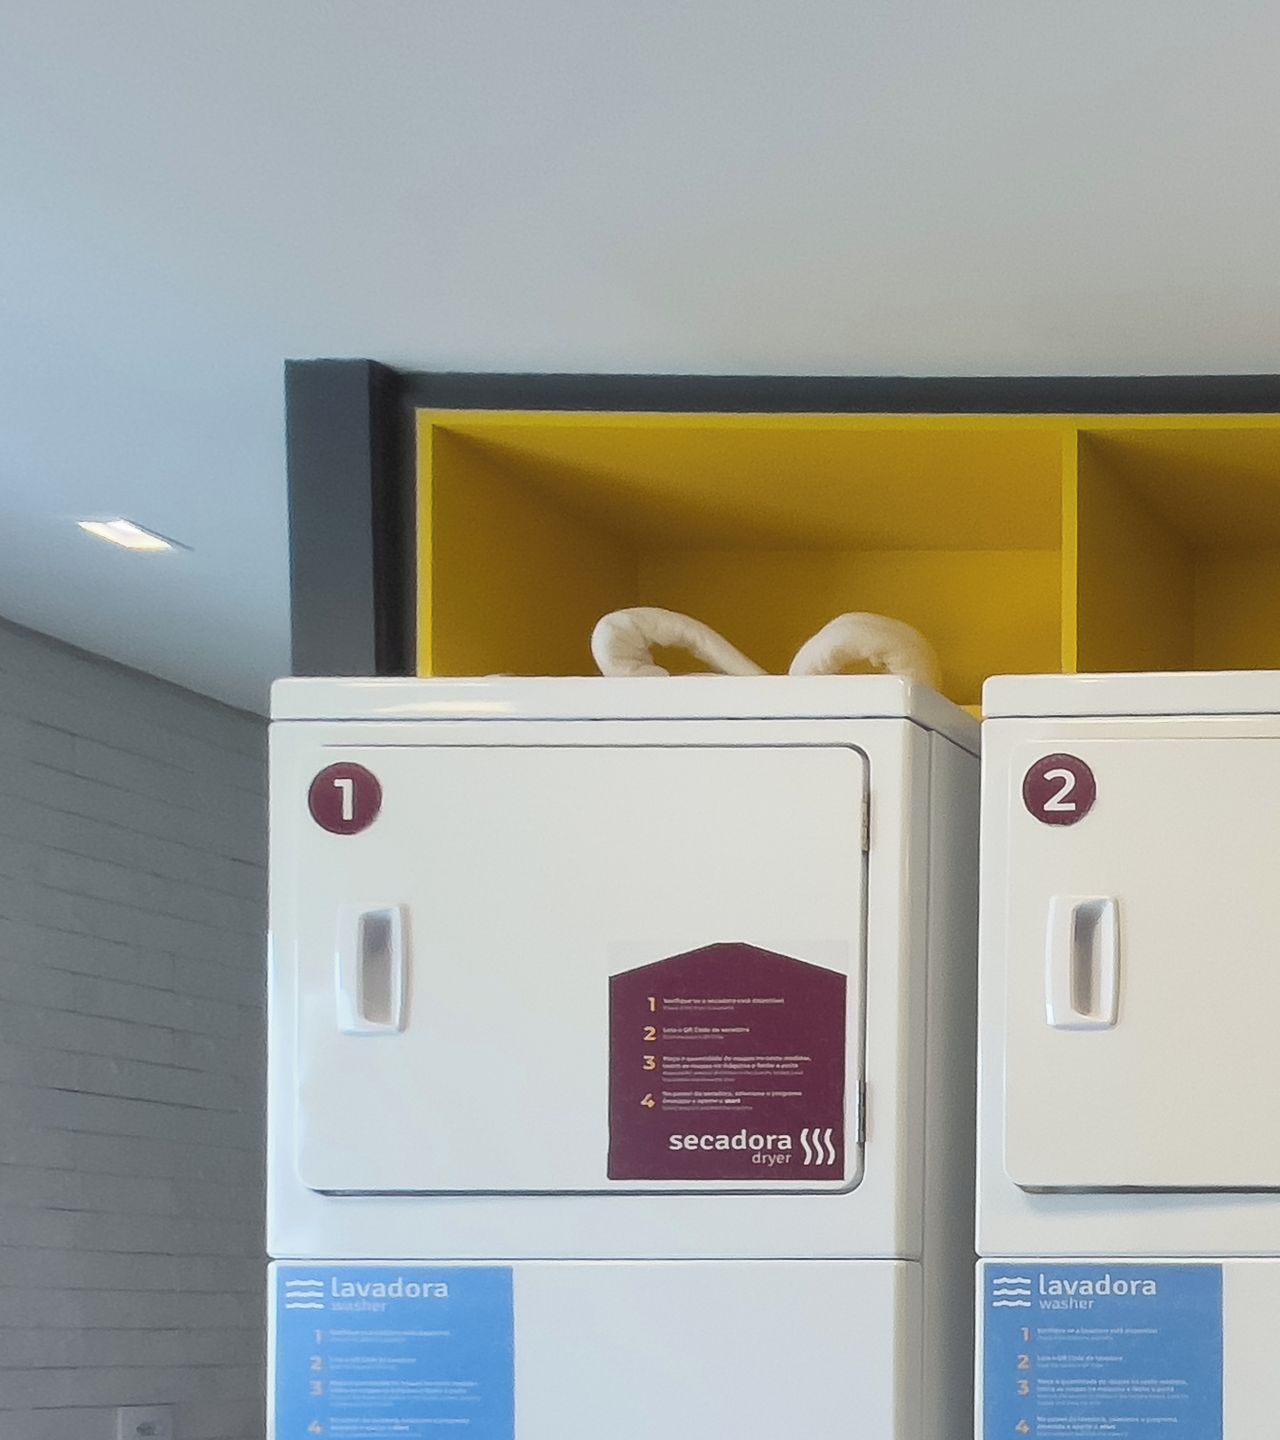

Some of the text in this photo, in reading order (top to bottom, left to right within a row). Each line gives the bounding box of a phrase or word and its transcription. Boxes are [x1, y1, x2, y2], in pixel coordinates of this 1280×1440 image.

[1043, 769, 1076, 812] 2
[334, 779, 354, 821] 1
[648, 997, 656, 1011] 1
[643, 1026, 657, 1041] 2
[642, 1055, 656, 1070] 3
[640, 1094, 656, 1108] 4
[669, 1129, 792, 1150] secadora
[751, 1152, 792, 1166] dryer
[330, 1277, 449, 1298] lavadora
[1039, 1274, 1157, 1296] lavadora
[1039, 1297, 1095, 1310] washer
[1021, 1327, 1030, 1341] 1
[1017, 1355, 1030, 1369] 2
[1017, 1380, 1030, 1395] 3
[1015, 1421, 1030, 1435] 4
